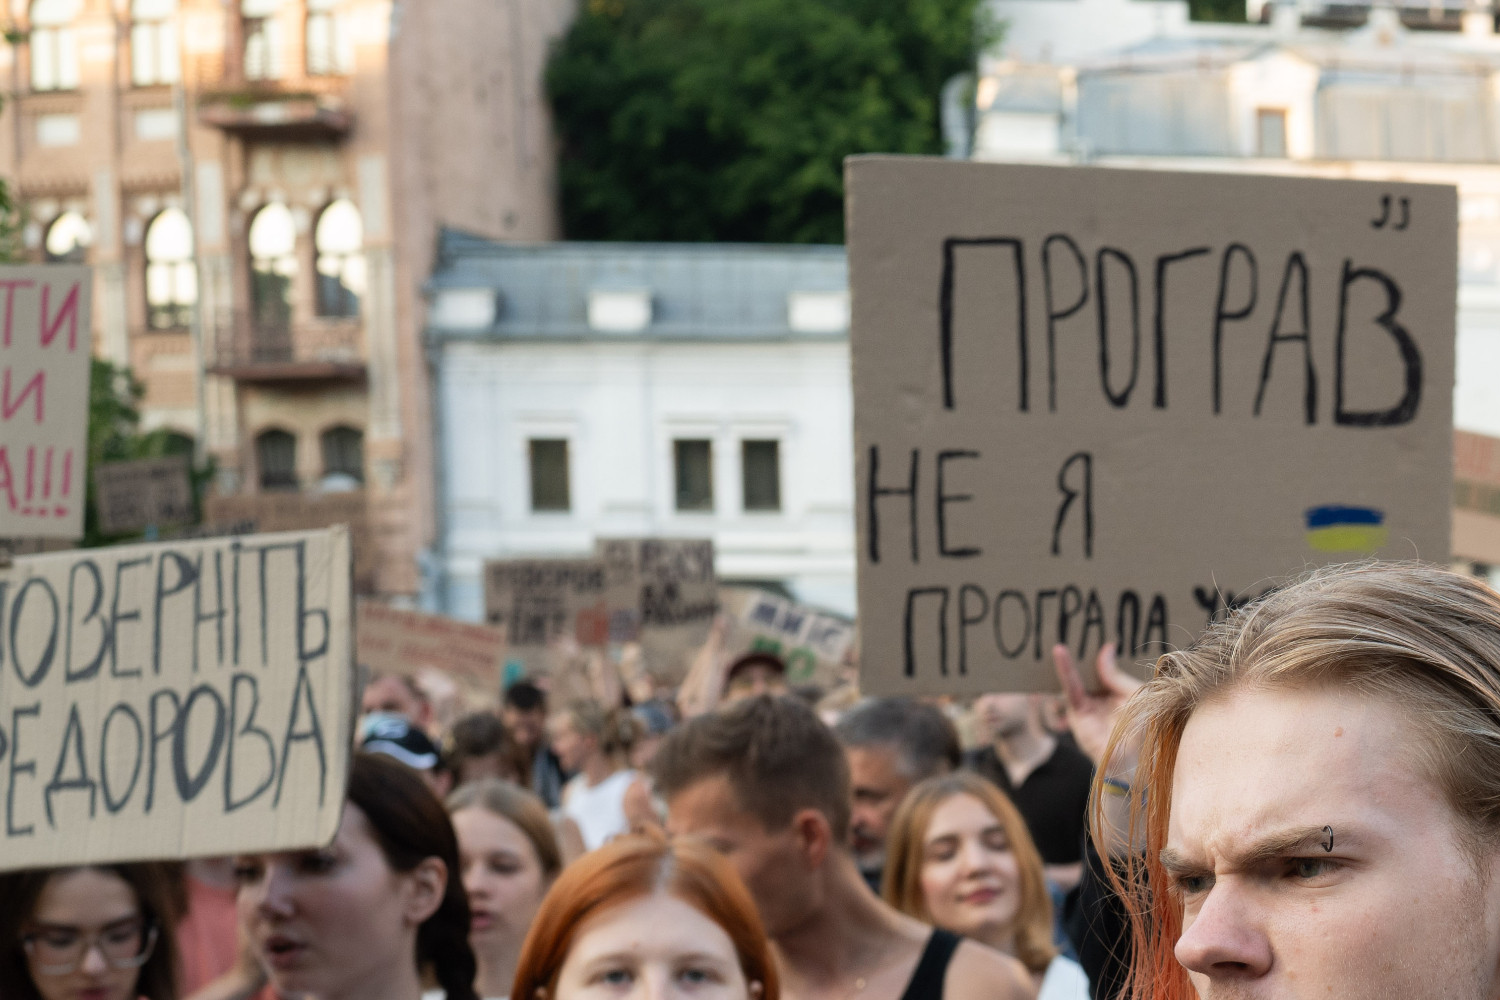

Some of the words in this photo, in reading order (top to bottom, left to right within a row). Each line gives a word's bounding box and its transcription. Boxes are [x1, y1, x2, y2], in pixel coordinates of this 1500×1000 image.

[867, 444, 982, 565] НЕ
[1050, 451, 1095, 560] Я
[0, 537, 330, 689] ОВЕРНІТЬ
[0, 662, 328, 838] ЕДОРОВА
